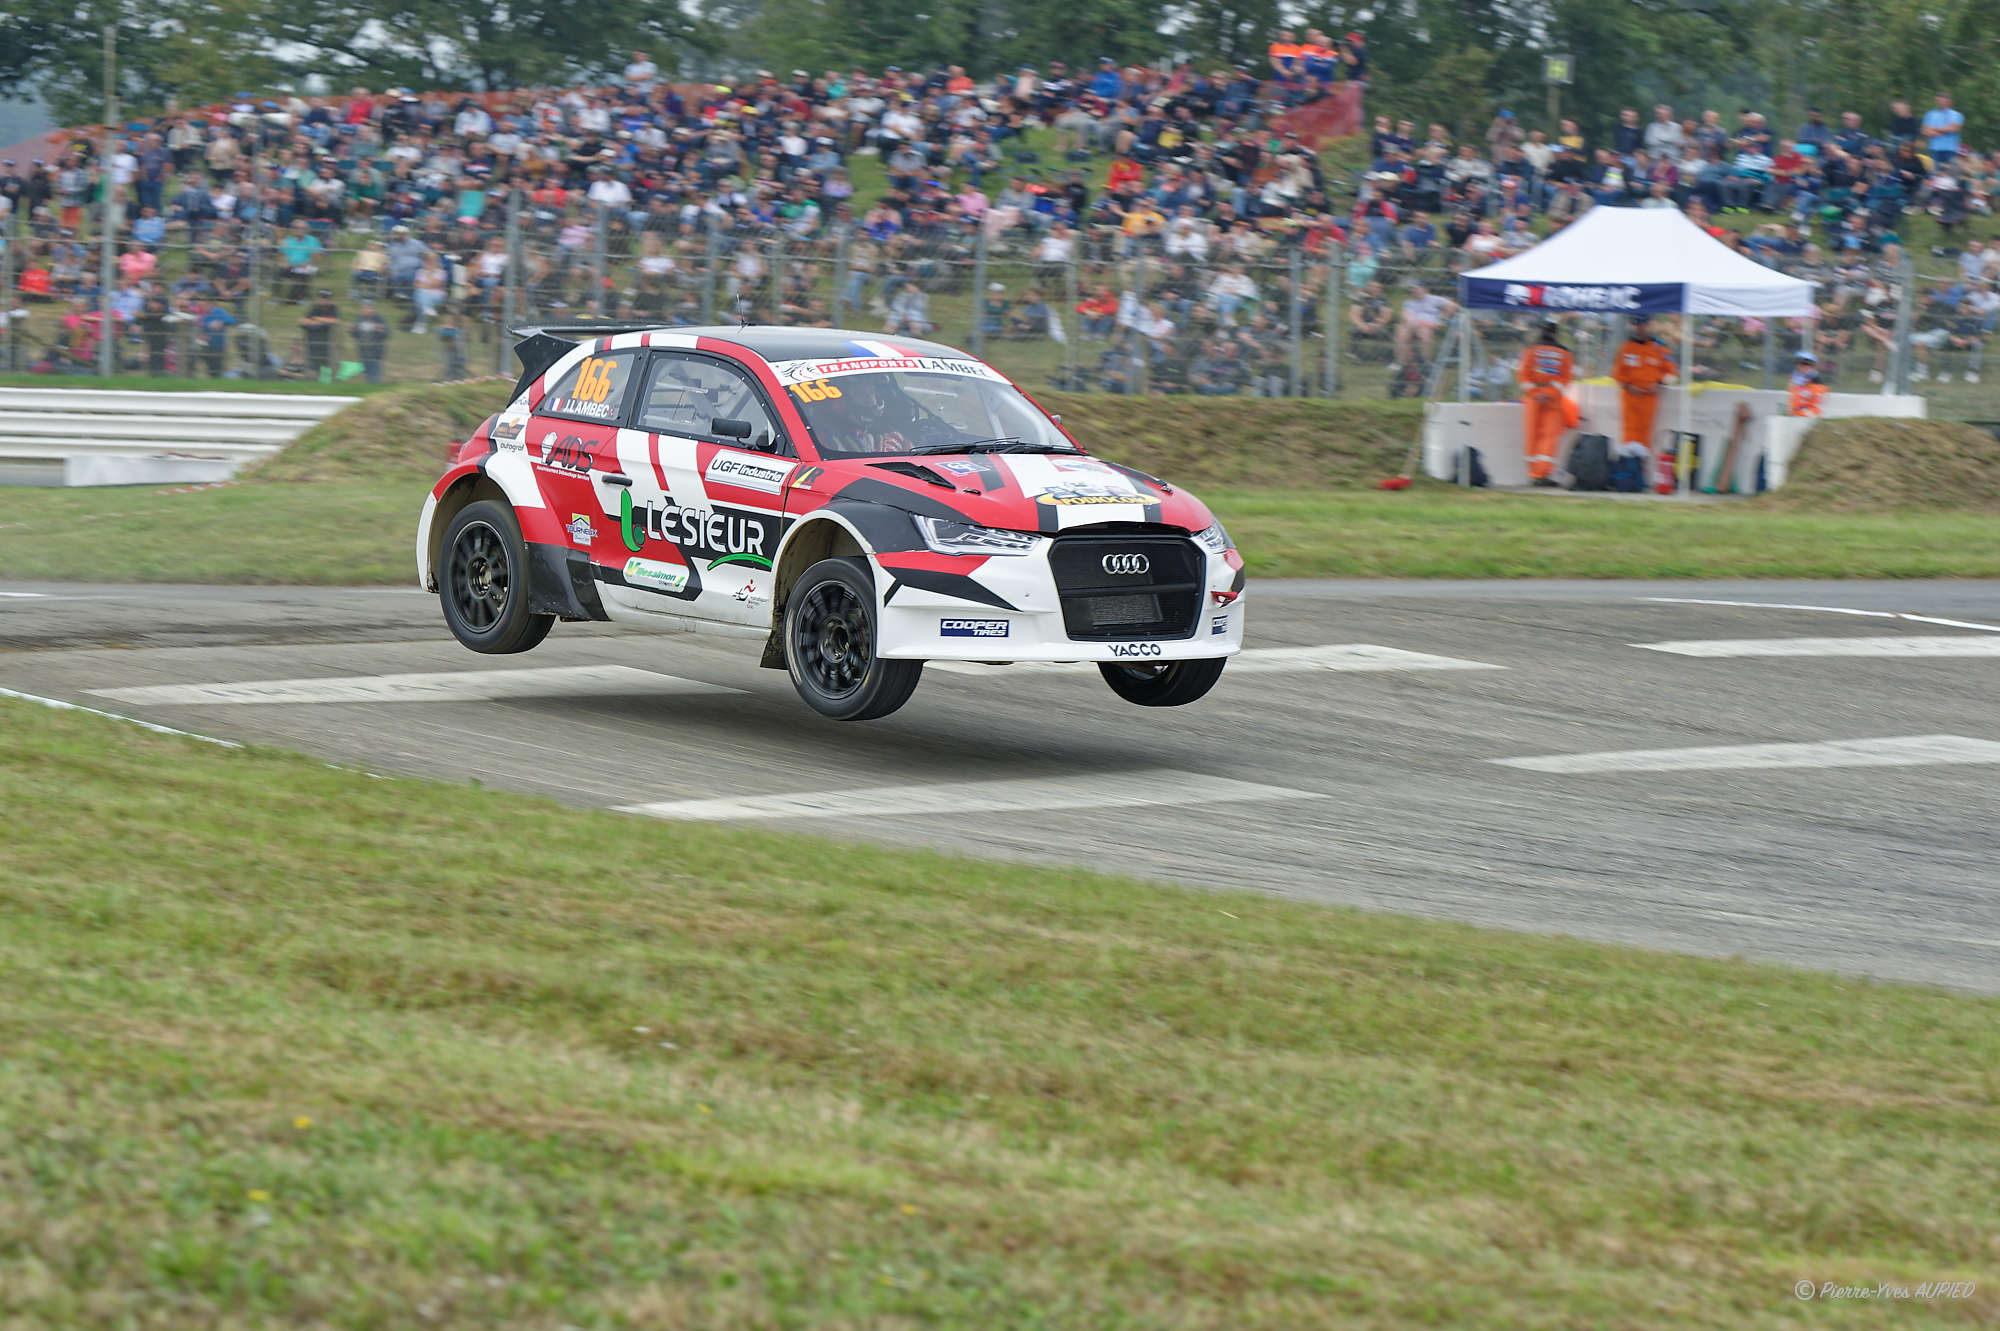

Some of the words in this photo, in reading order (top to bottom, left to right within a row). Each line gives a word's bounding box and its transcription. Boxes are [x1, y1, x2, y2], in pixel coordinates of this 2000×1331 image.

[819, 359, 916, 374] TRANSPORTS
[572, 357, 617, 403] 166
[790, 379, 842, 403] 166
[563, 399, 609, 417] J.LAMBEC
[711, 459, 741, 475] UGF
[647, 500, 765, 556] LESIEUR
[941, 621, 1009, 630] COOPER
[972, 629, 1007, 637] TIRES
[1107, 643, 1162, 657] YACCO
